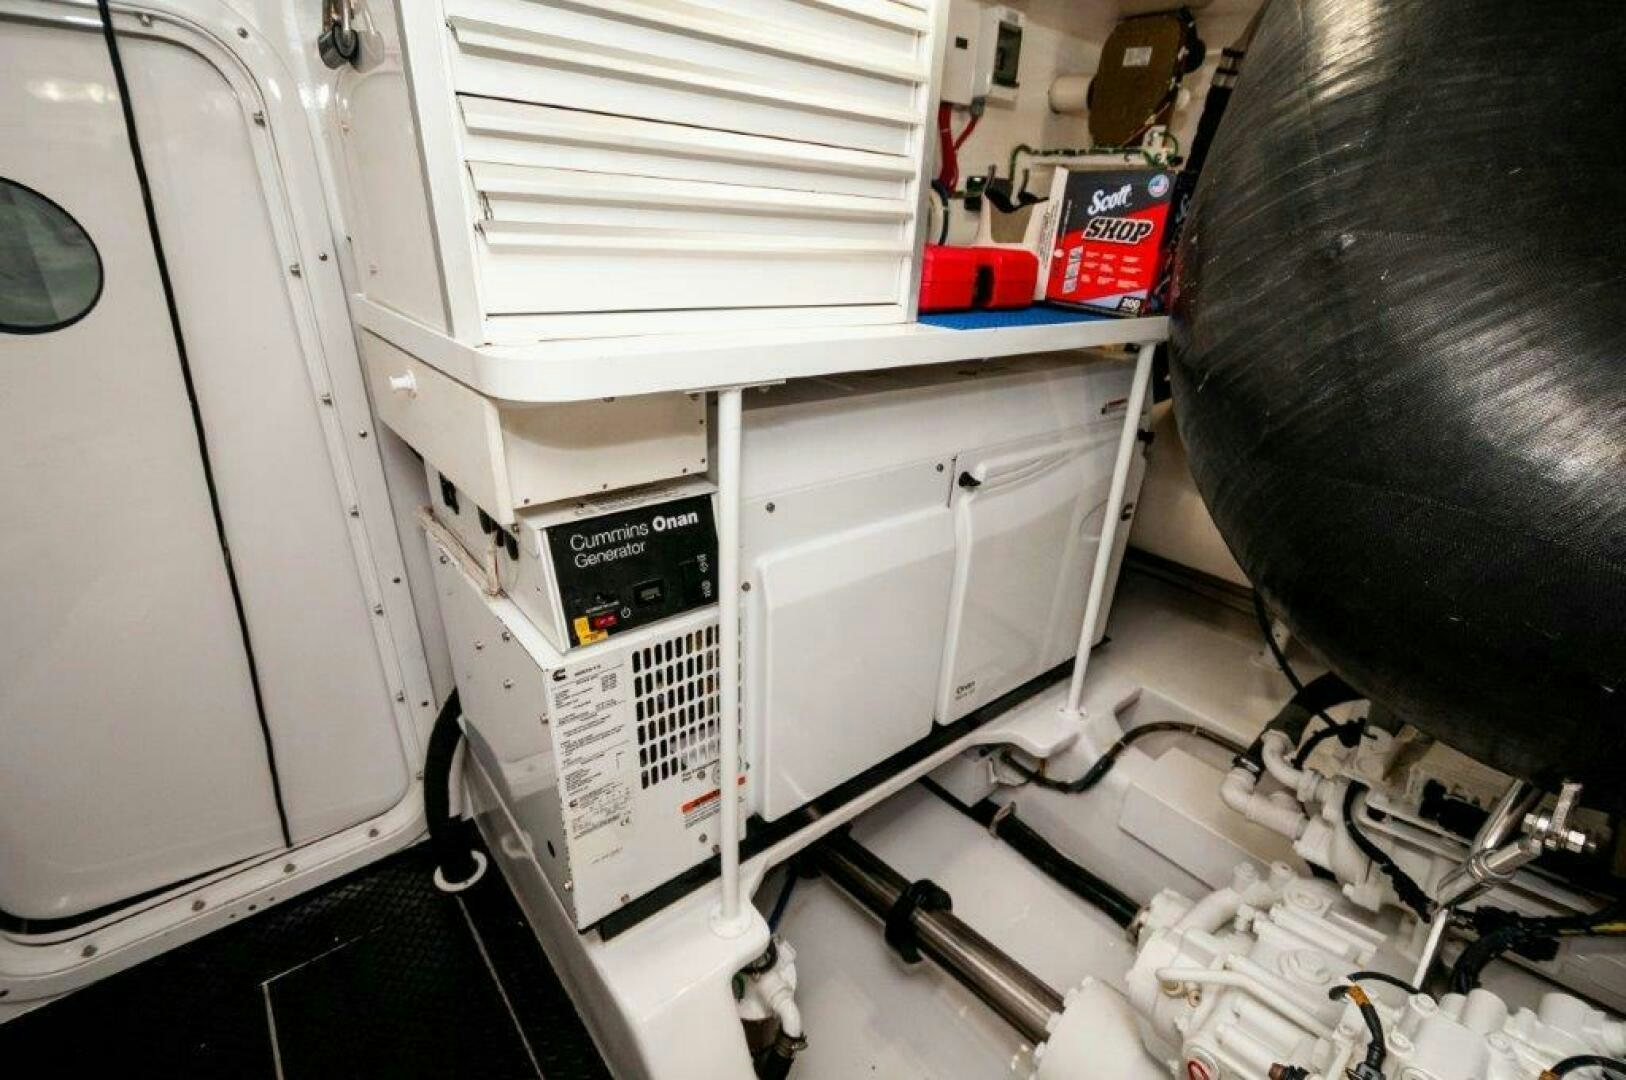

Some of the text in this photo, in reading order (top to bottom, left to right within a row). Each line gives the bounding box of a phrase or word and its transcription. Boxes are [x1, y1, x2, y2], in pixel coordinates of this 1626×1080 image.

[1087, 184, 1132, 215] Scott
[1082, 216, 1154, 244] SHOP
[570, 511, 698, 551] Cummins Onan
[574, 541, 646, 568] Generator
